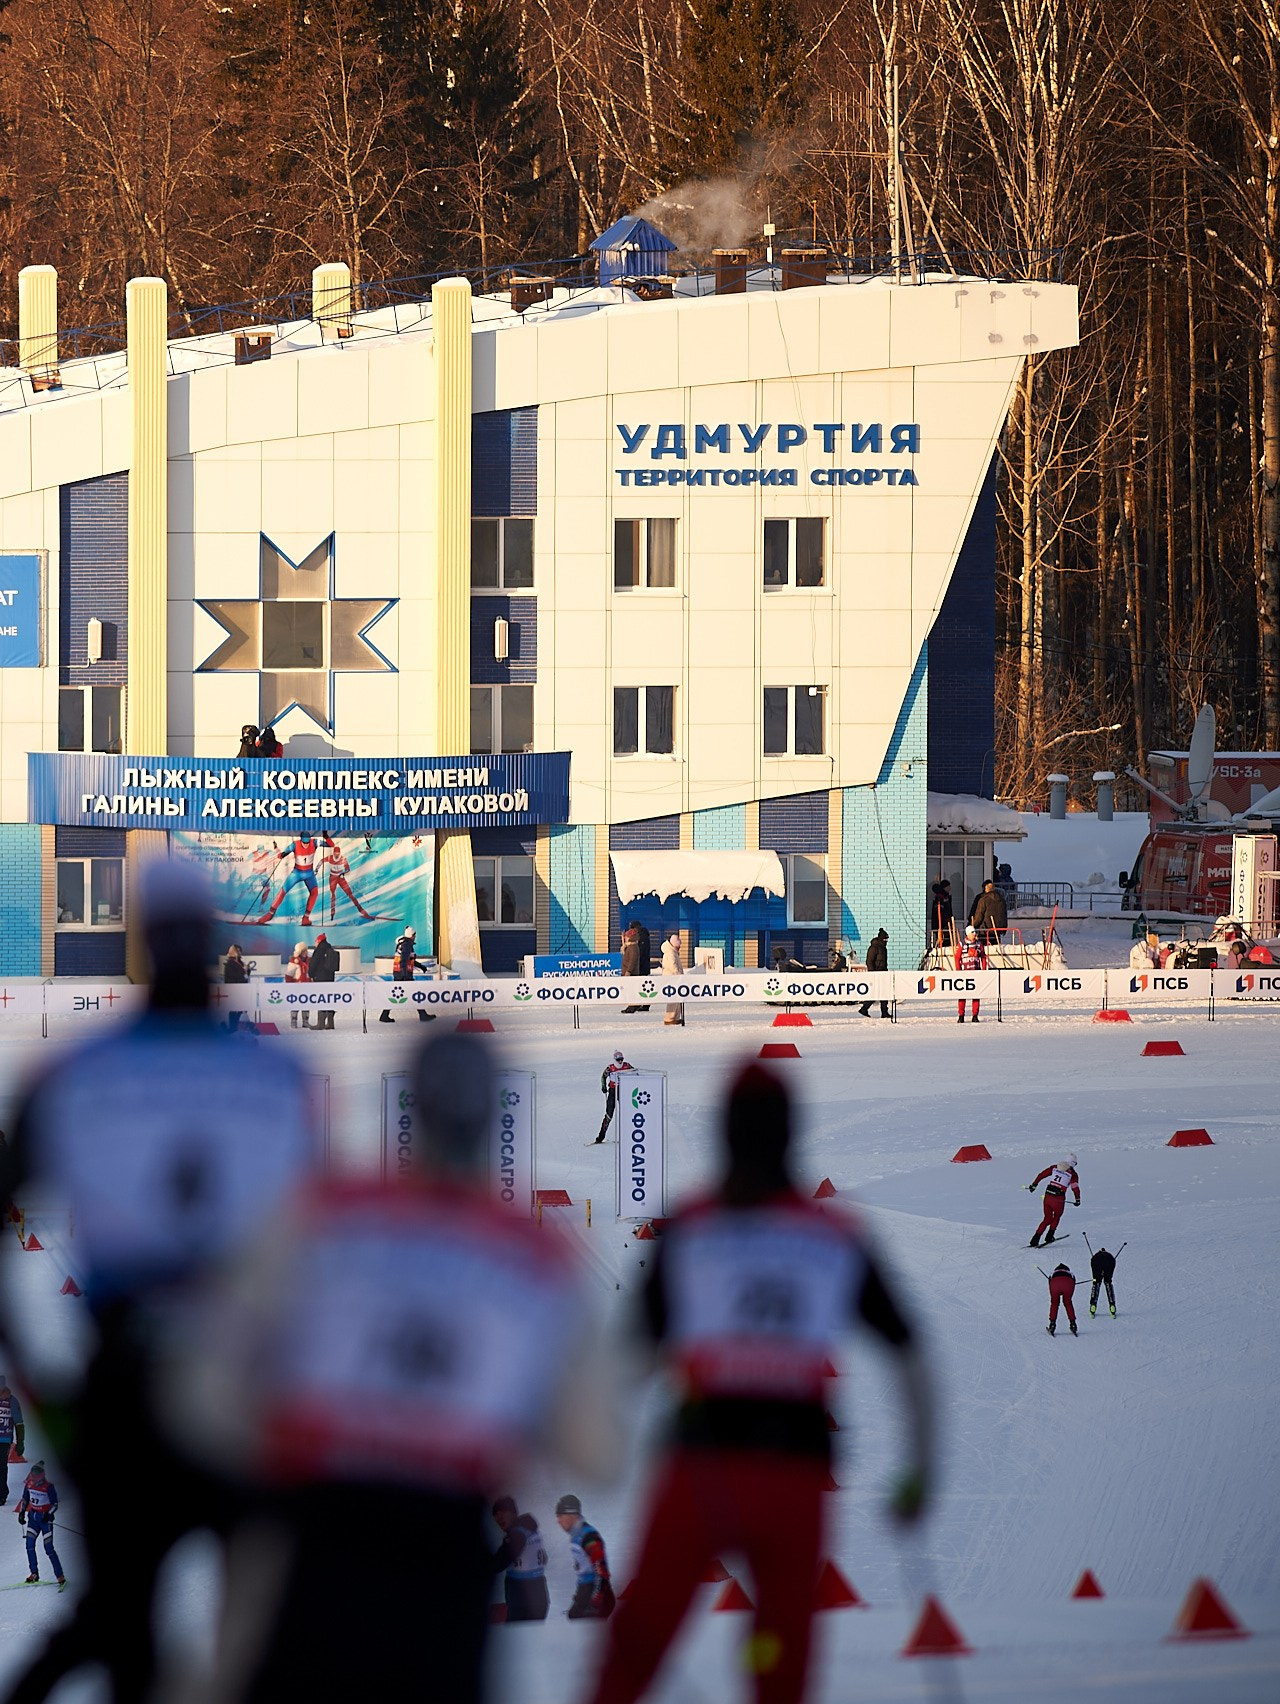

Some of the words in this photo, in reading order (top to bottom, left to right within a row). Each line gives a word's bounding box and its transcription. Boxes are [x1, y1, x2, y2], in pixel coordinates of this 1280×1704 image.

[616, 423, 920, 460] УДМУРТИЯ
[615, 468, 798, 486] ТЕРРИТОРИЯ
[810, 468, 919, 486] СПОРТА
[122, 766, 244, 790] ЛЫЖНЫЙ
[263, 769, 399, 791] КОМПЛЕКС
[408, 767, 489, 788] ИМЕНИ
[81, 794, 186, 817] ГАЛИНЫ
[201, 797, 379, 818] АЛЕКСЕЕВНЫ
[394, 787, 529, 816] КУЛАКОВОЙ
[558, 959, 611, 969] ТЕХНОПАРК
[662, 983, 745, 998] ФОСАГРО
[787, 981, 869, 996] ФОСАГРО
[941, 978, 976, 992] ПСБ
[1047, 977, 1081, 991] ПСБ
[1153, 977, 1188, 991] ПСБ
[1259, 977, 1280, 991] ПС
[286, 993, 352, 1004] ФОСАГРО
[411, 988, 495, 1004] ФОСАГРО
[536, 986, 620, 1000] ФОСАГРО
[500, 1112, 515, 1202] ФОСАГРО
[631, 1112, 646, 1202] ФОСАГРО
